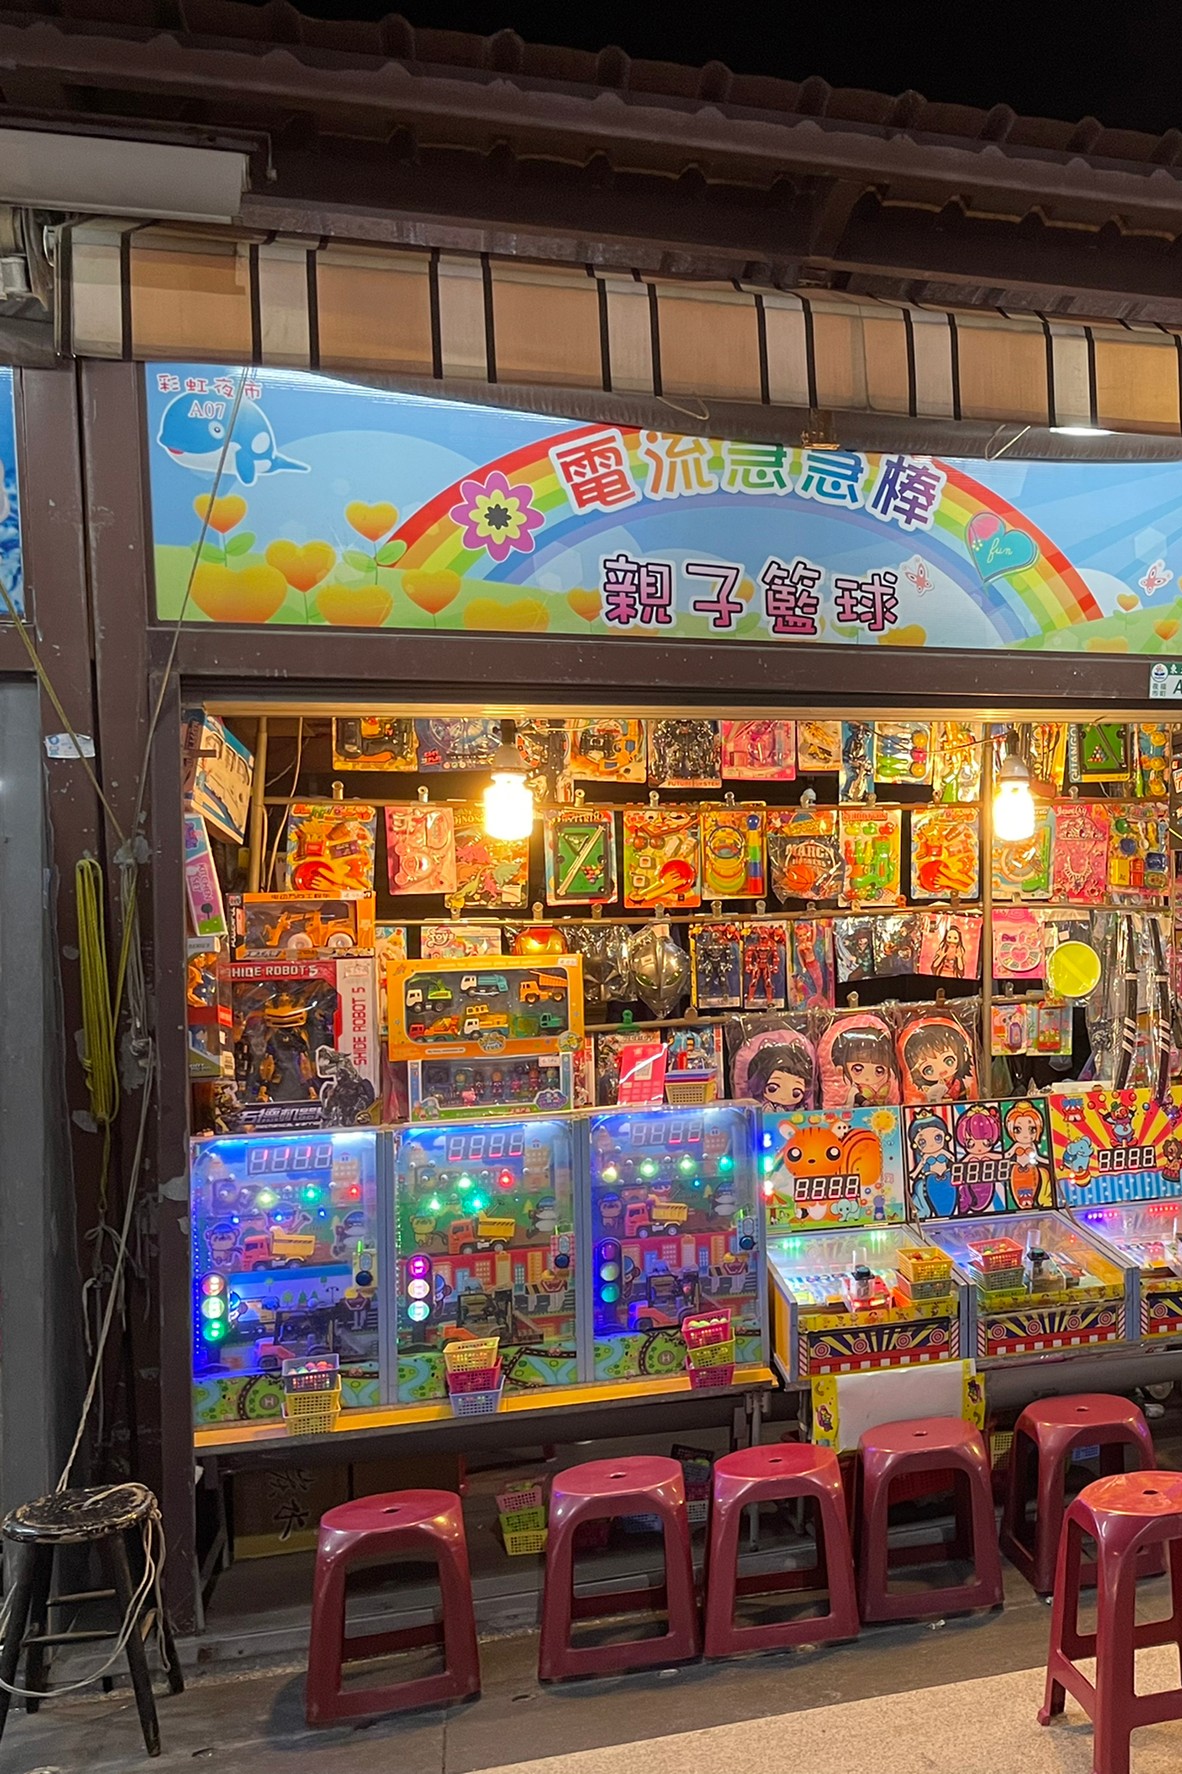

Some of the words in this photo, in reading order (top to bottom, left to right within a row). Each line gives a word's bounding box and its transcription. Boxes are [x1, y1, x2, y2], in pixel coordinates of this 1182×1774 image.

[156, 373, 262, 400] 彩虹夜市
[188, 400, 226, 420] A07
[555, 429, 945, 529] 電流急急棒
[602, 554, 899, 637] 親子籃球
[191, 877, 201, 891] SET
[198, 863, 213, 900] KITCHEN
[266, 964, 305, 977] ROBOT
[352, 986, 366, 994] 5
[353, 997, 367, 1029] ROBOT
[353, 1032, 368, 1066] SHIDE
